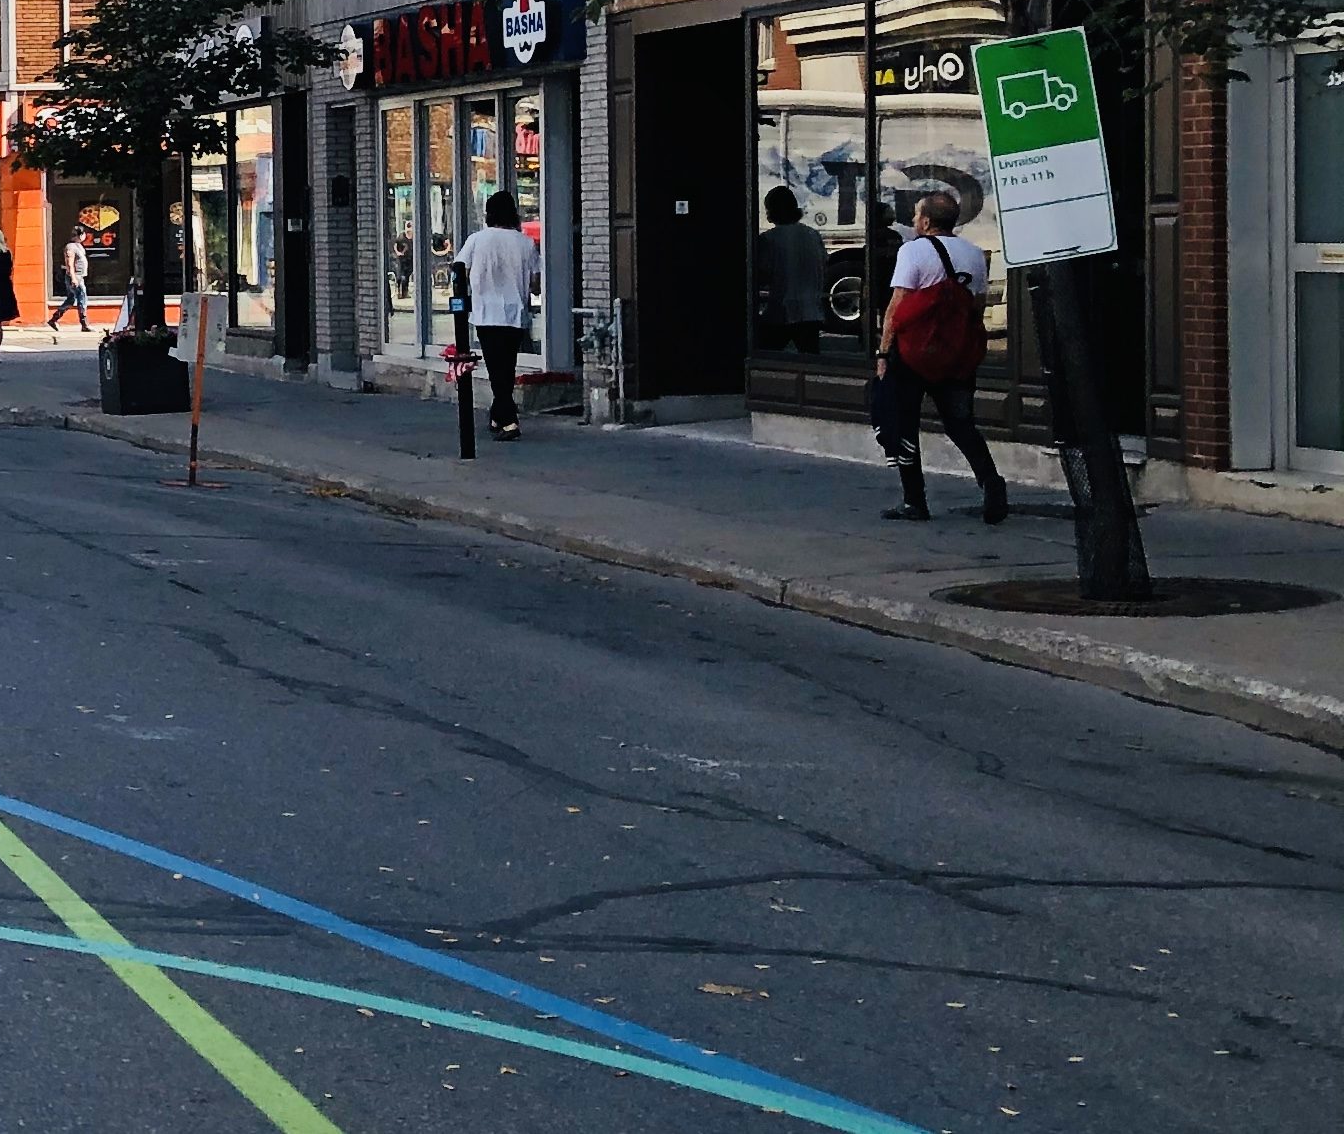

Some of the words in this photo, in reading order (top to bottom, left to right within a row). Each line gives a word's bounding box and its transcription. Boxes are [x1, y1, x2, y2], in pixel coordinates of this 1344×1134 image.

[505, 11, 544, 37] BASHA
[373, 0, 492, 88] BASHA
[998, 154, 1048, 170] Livraison
[1001, 177, 1008, 186] 7
[1010, 175, 1018, 185] h
[1021, 173, 1029, 184] à
[1031, 170, 1043, 181] 11
[1045, 169, 1055, 180] h
